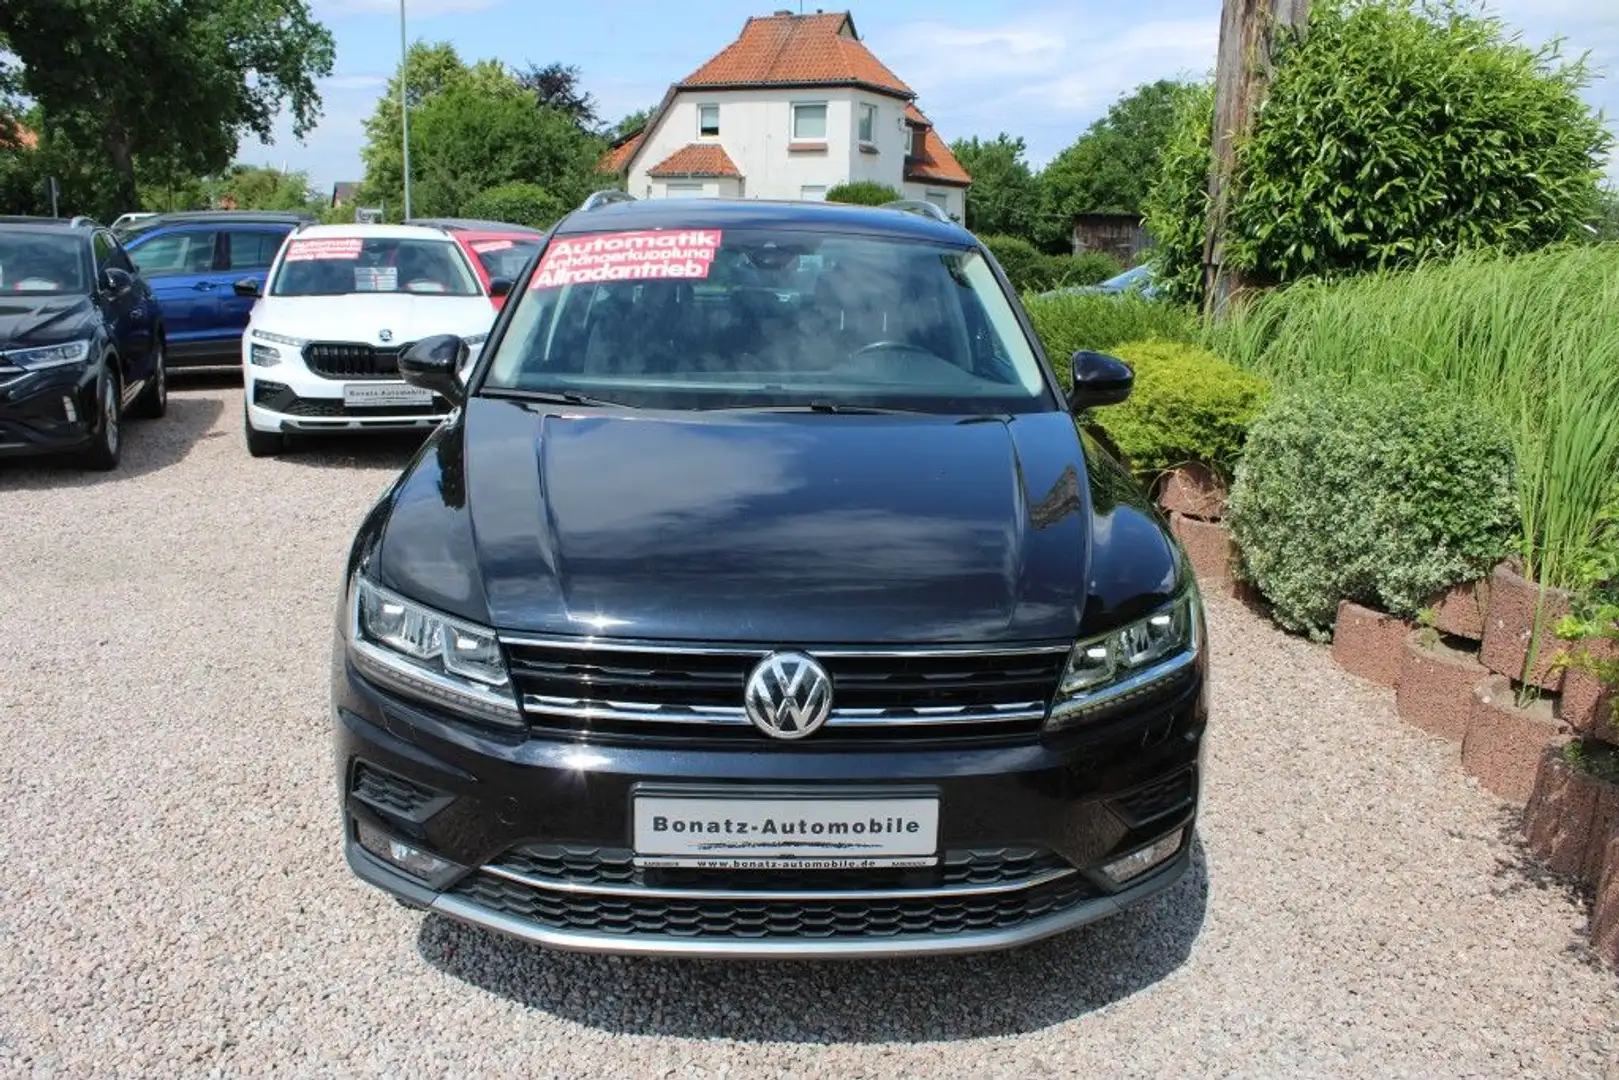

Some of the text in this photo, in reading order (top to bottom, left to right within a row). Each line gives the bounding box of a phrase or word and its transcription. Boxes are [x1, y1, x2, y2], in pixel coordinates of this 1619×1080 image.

[551, 230, 716, 257] Automatik
[533, 260, 703, 289] Allradantrieb
[652, 816, 920, 834] Bonatz-Automobile
[697, 859, 876, 868] www.bonatz-automobile.de
